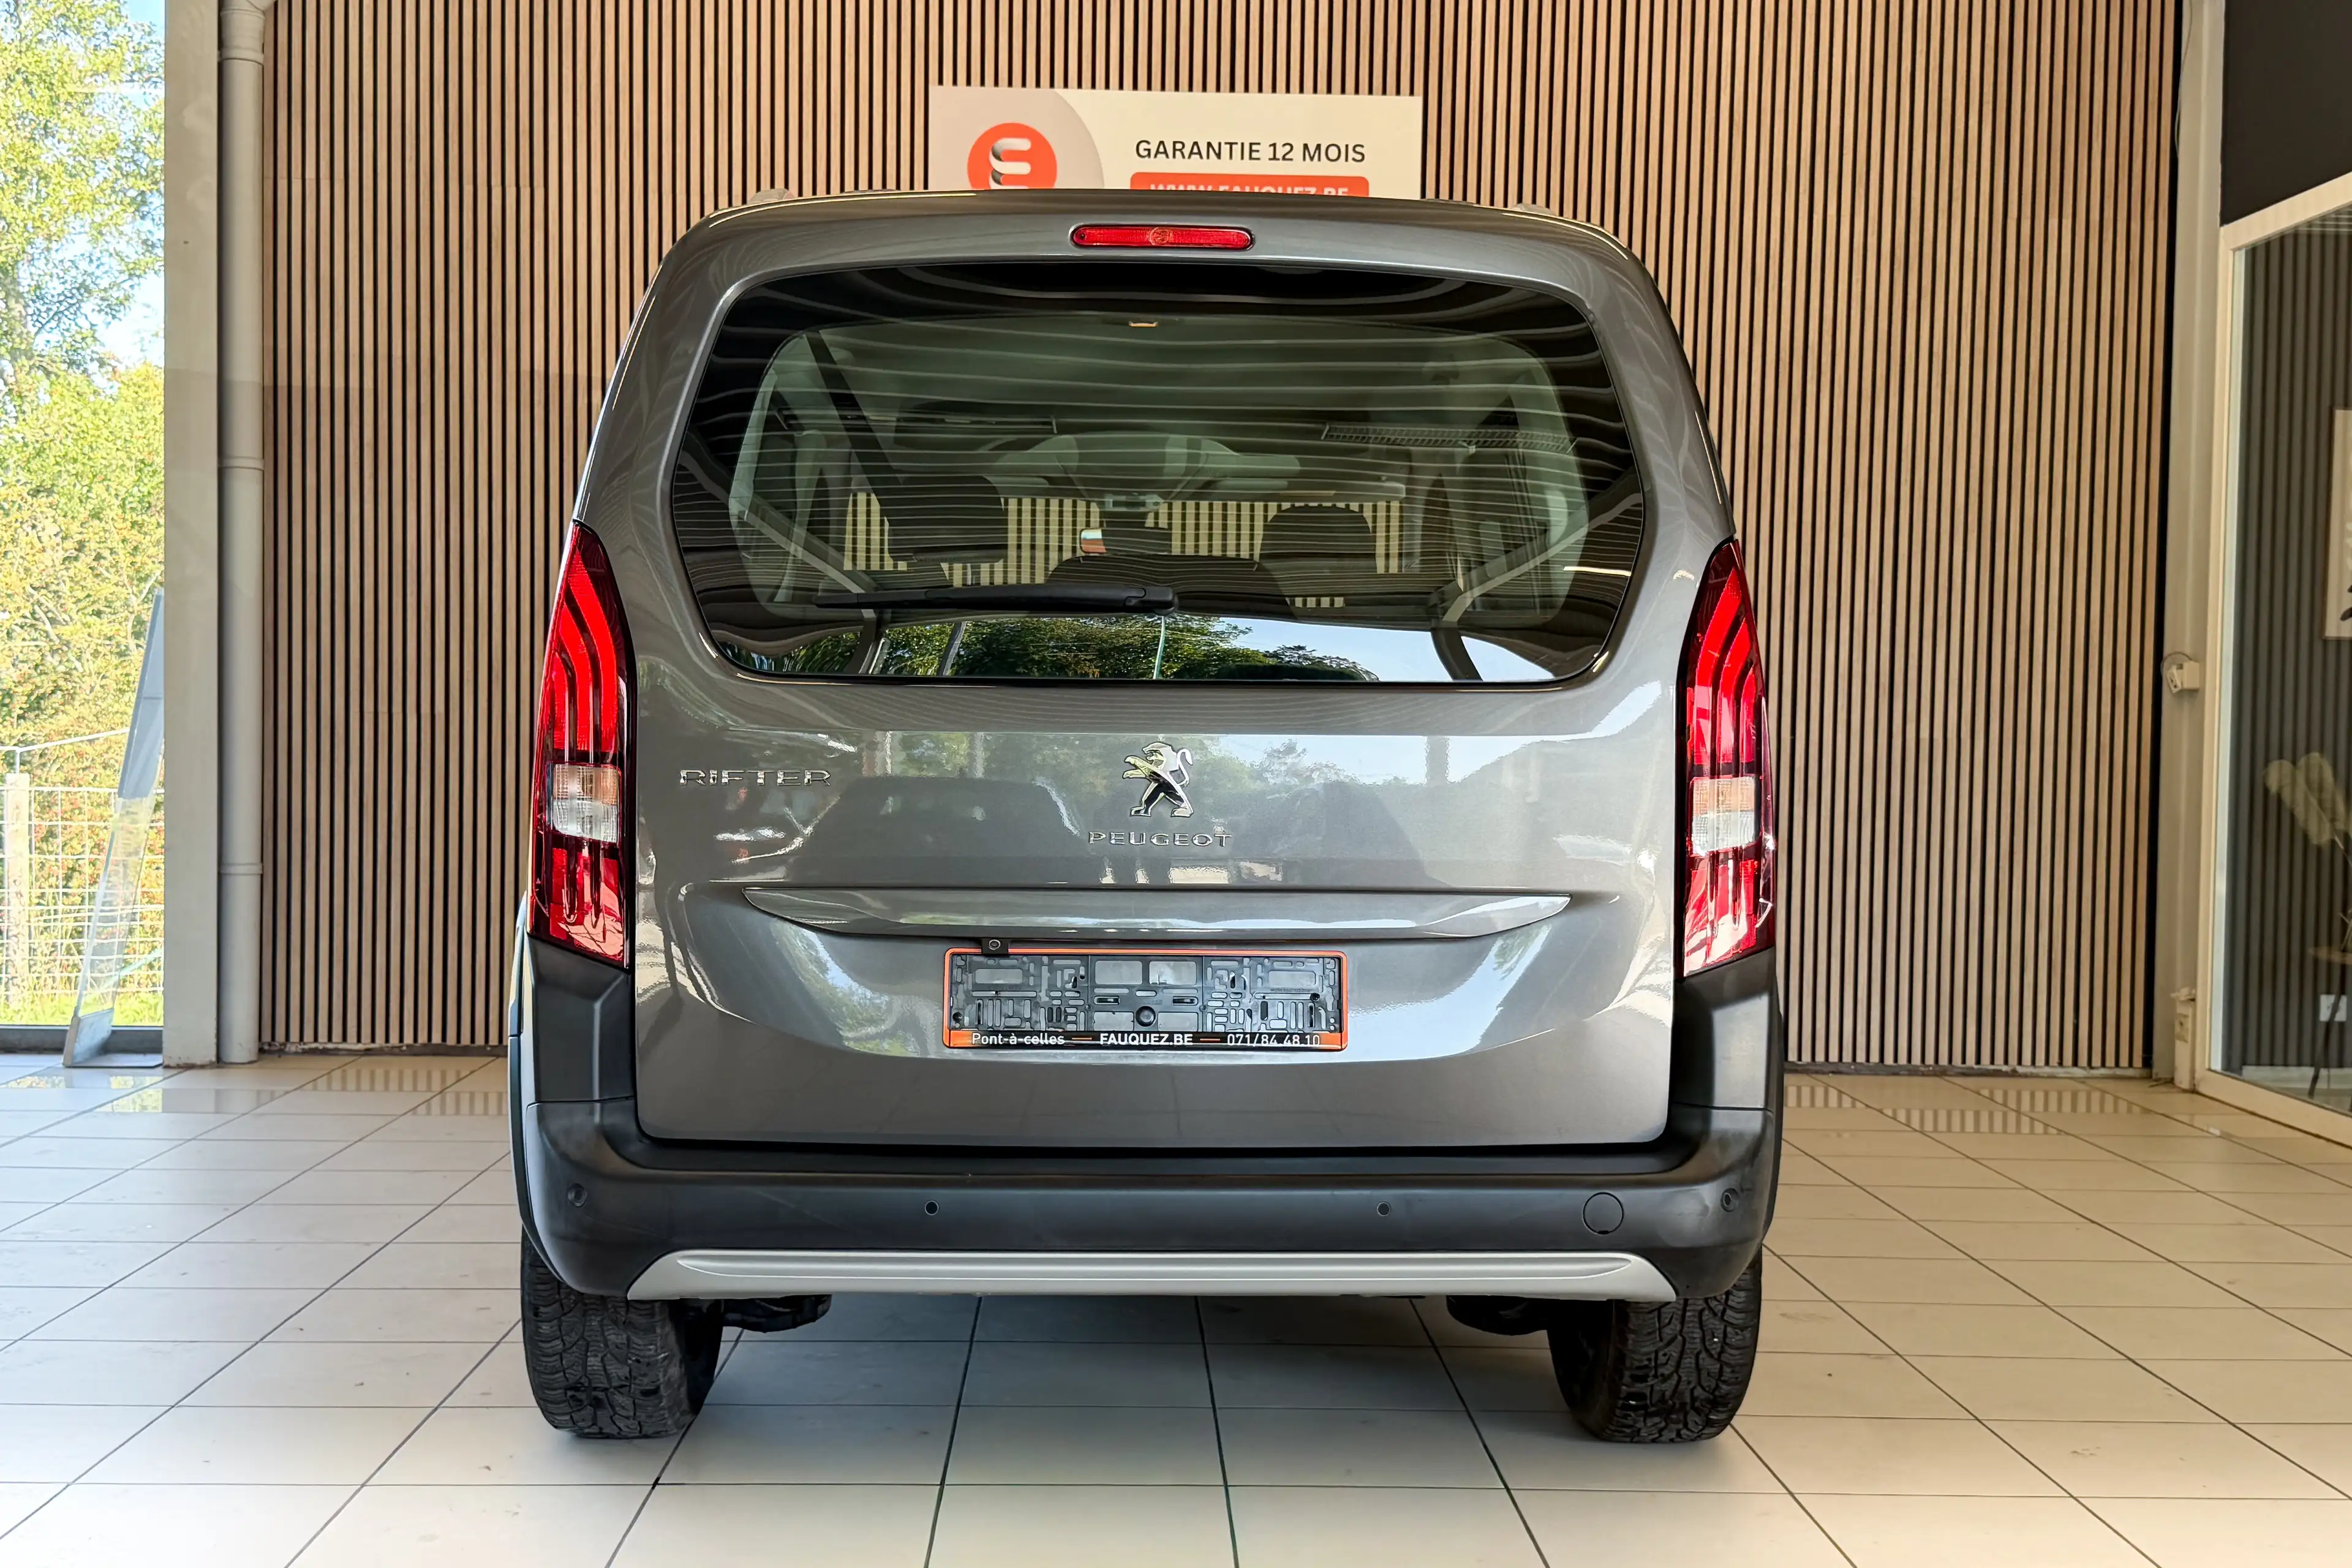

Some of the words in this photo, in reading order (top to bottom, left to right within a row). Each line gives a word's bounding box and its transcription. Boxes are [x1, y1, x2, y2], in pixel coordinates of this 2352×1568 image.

[1135, 140, 1262, 161] GARANTIE
[1268, 142, 1294, 162] 12
[1302, 143, 1366, 162] MOIS
[680, 769, 831, 786] RIFTER
[1088, 831, 1232, 847] PEUGEOT
[971, 1032, 1065, 1045] Pont-à-celles
[1099, 1033, 1193, 1046] FAUQUEZ.BE
